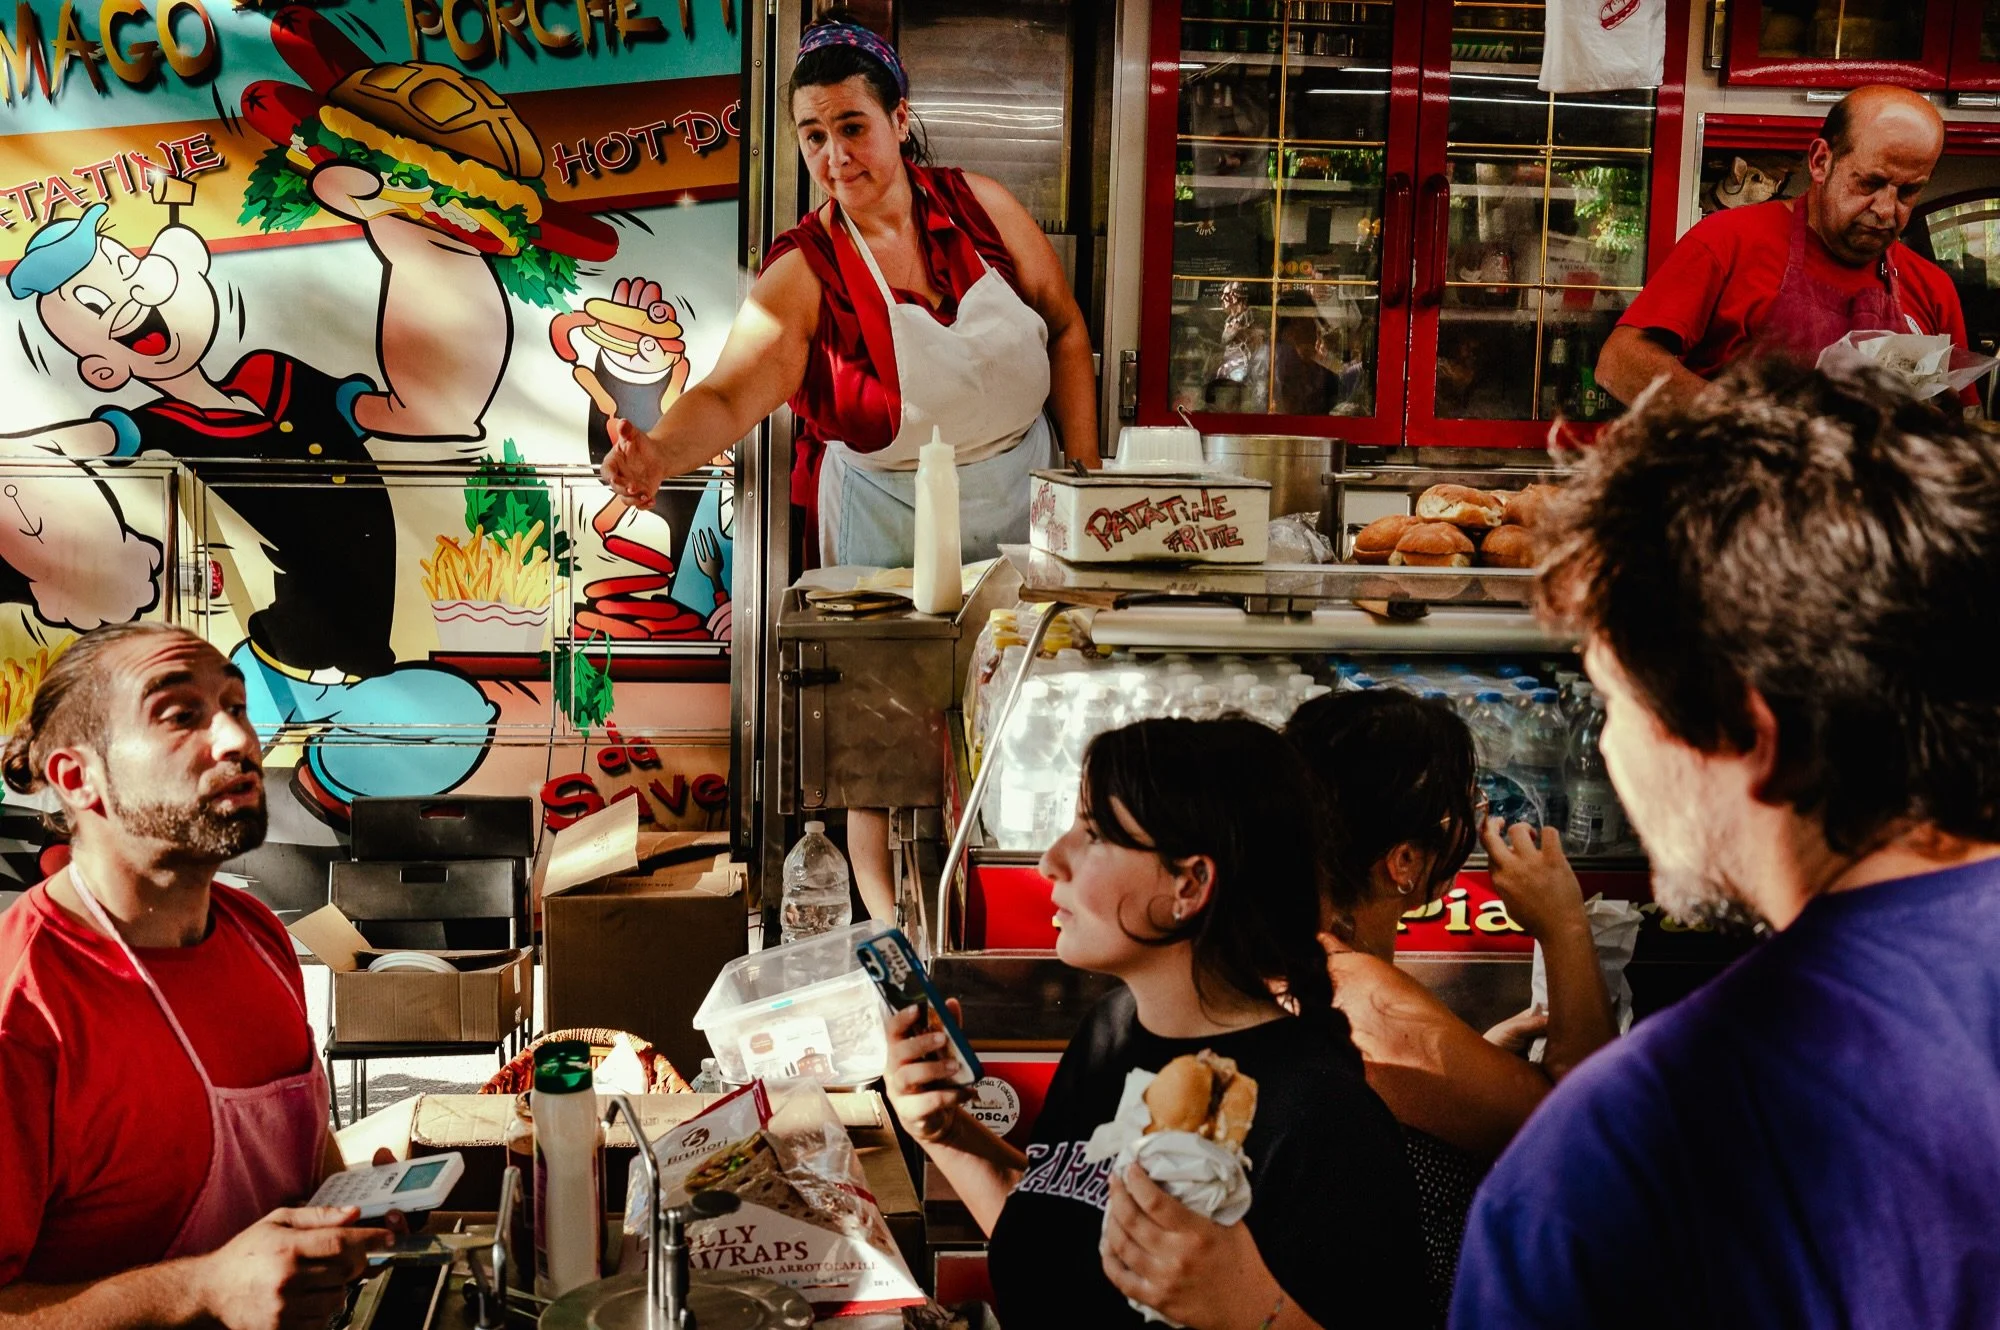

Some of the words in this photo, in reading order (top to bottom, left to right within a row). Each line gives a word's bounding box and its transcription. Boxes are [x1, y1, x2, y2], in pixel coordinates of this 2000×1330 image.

[552, 121, 666, 184] HOT
[0, 132, 222, 230] TATINE
[597, 720, 659, 768] da
[971, 1112, 1010, 1124] OSCA
